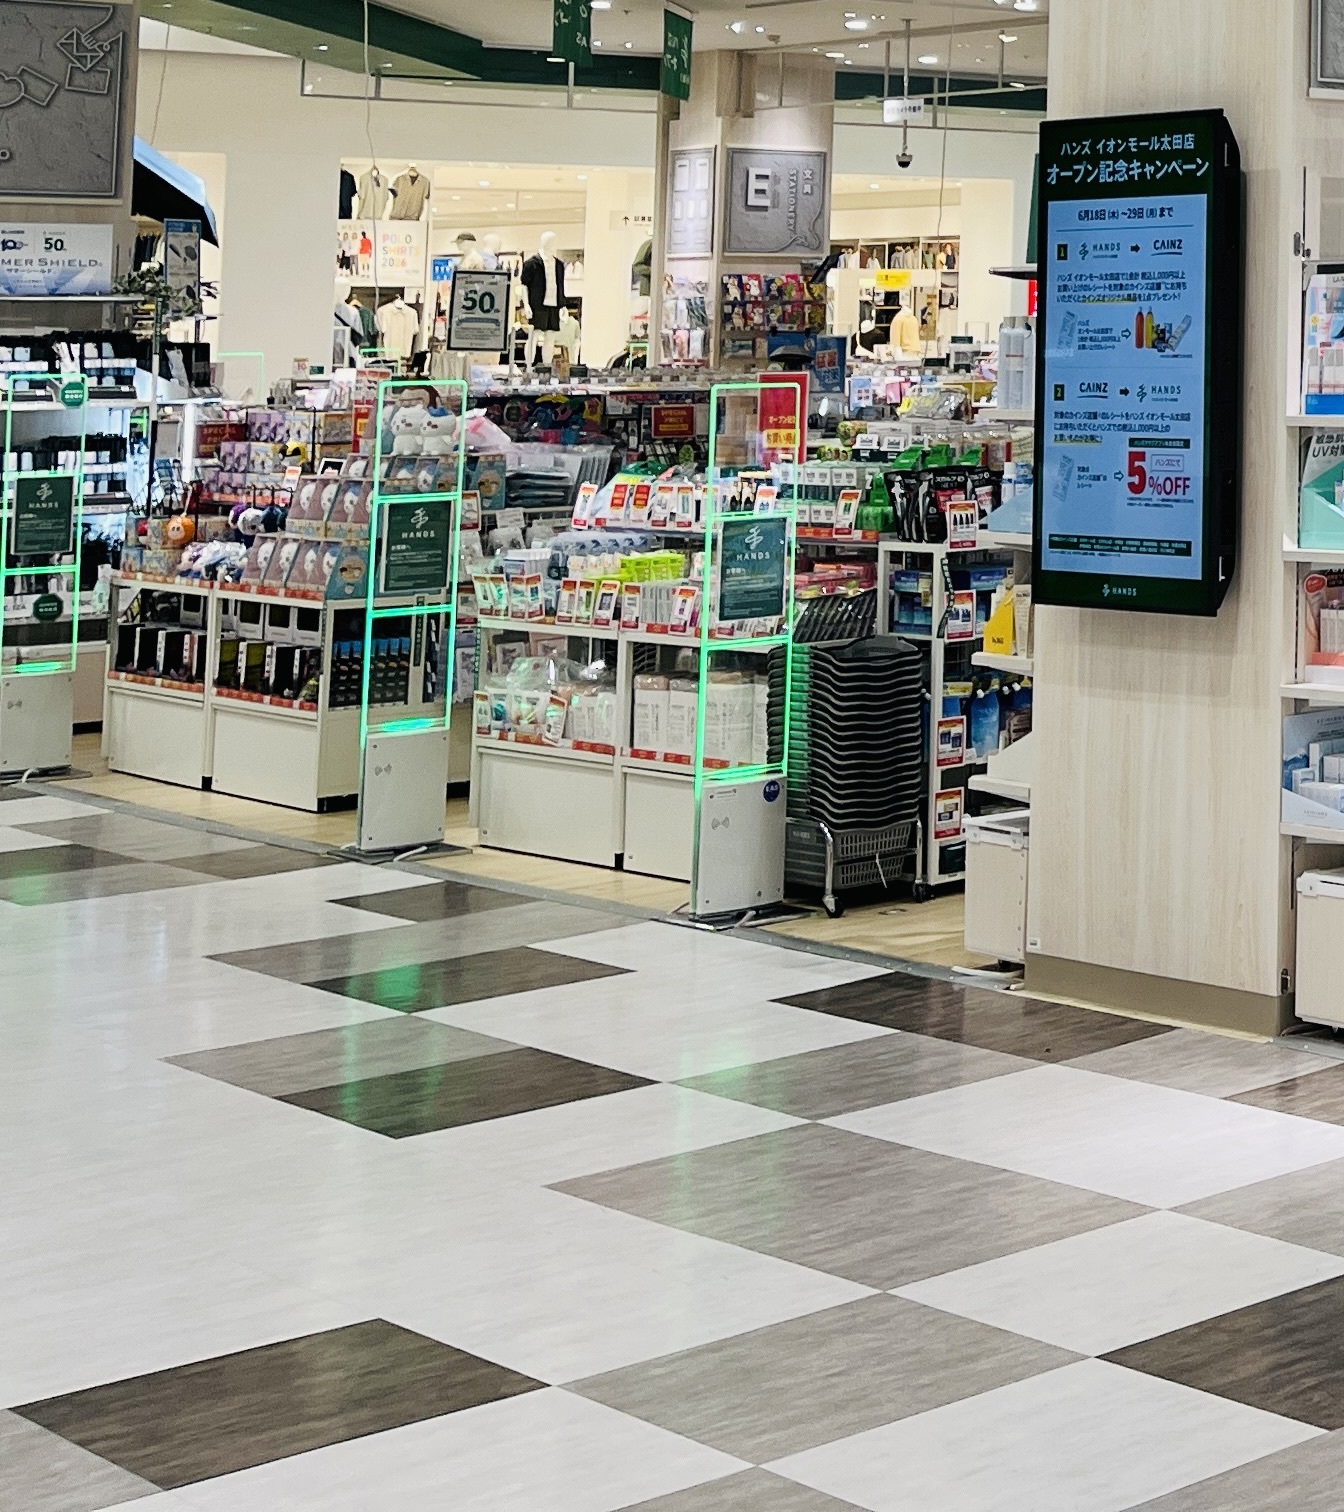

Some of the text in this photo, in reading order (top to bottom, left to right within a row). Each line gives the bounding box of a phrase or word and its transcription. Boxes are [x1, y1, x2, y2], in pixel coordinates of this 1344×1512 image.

[1061, 133, 1195, 156] ハンズ イオンモール太田店
[1047, 157, 1210, 185] オープン記念キャンペーン
[747, 167, 772, 206] E
[788, 168, 798, 232] STATIONERY
[1092, 242, 1121, 252] HANDS
[1153, 239, 1183, 250] CAINZ
[383, 245, 420, 256] SHIRTS
[37, 257, 99, 267] SHIELD
[1079, 382, 1108, 393] CAINZ
[1151, 385, 1181, 395] HANDS
[401, 529, 436, 539] HANDS
[736, 551, 771, 561] HANDS
[1112, 587, 1137, 596] HANDS
